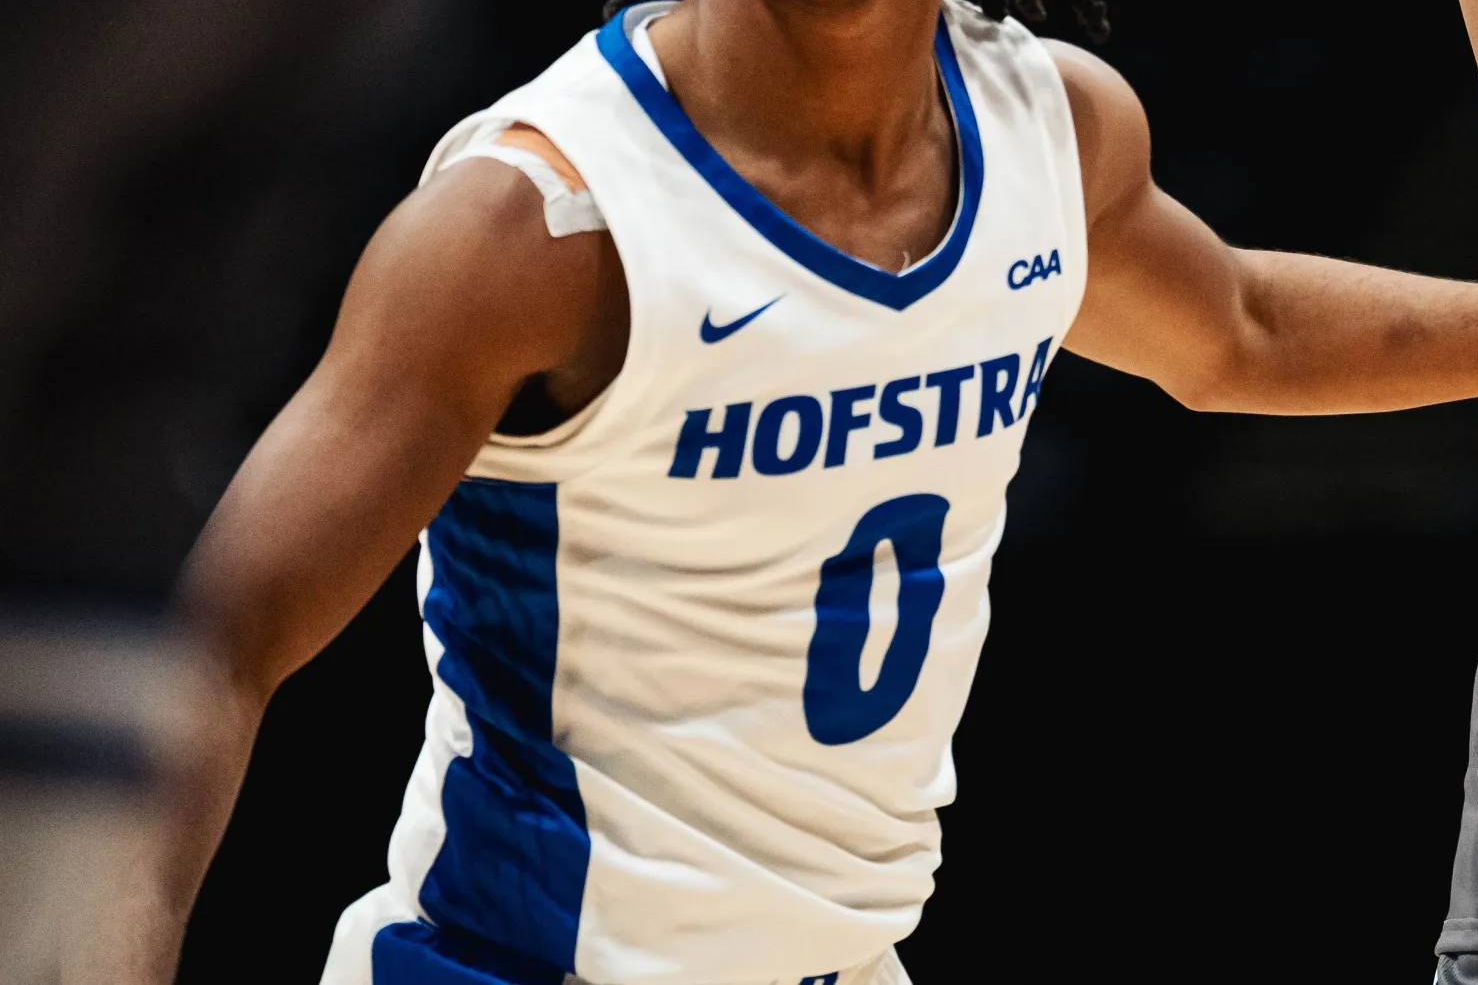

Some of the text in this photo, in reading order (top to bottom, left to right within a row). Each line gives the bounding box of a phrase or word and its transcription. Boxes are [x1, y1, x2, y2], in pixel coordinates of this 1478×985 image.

[1007, 249, 1062, 290] CAA
[667, 335, 1054, 480] HOFSTRA
[803, 493, 950, 746] 0
